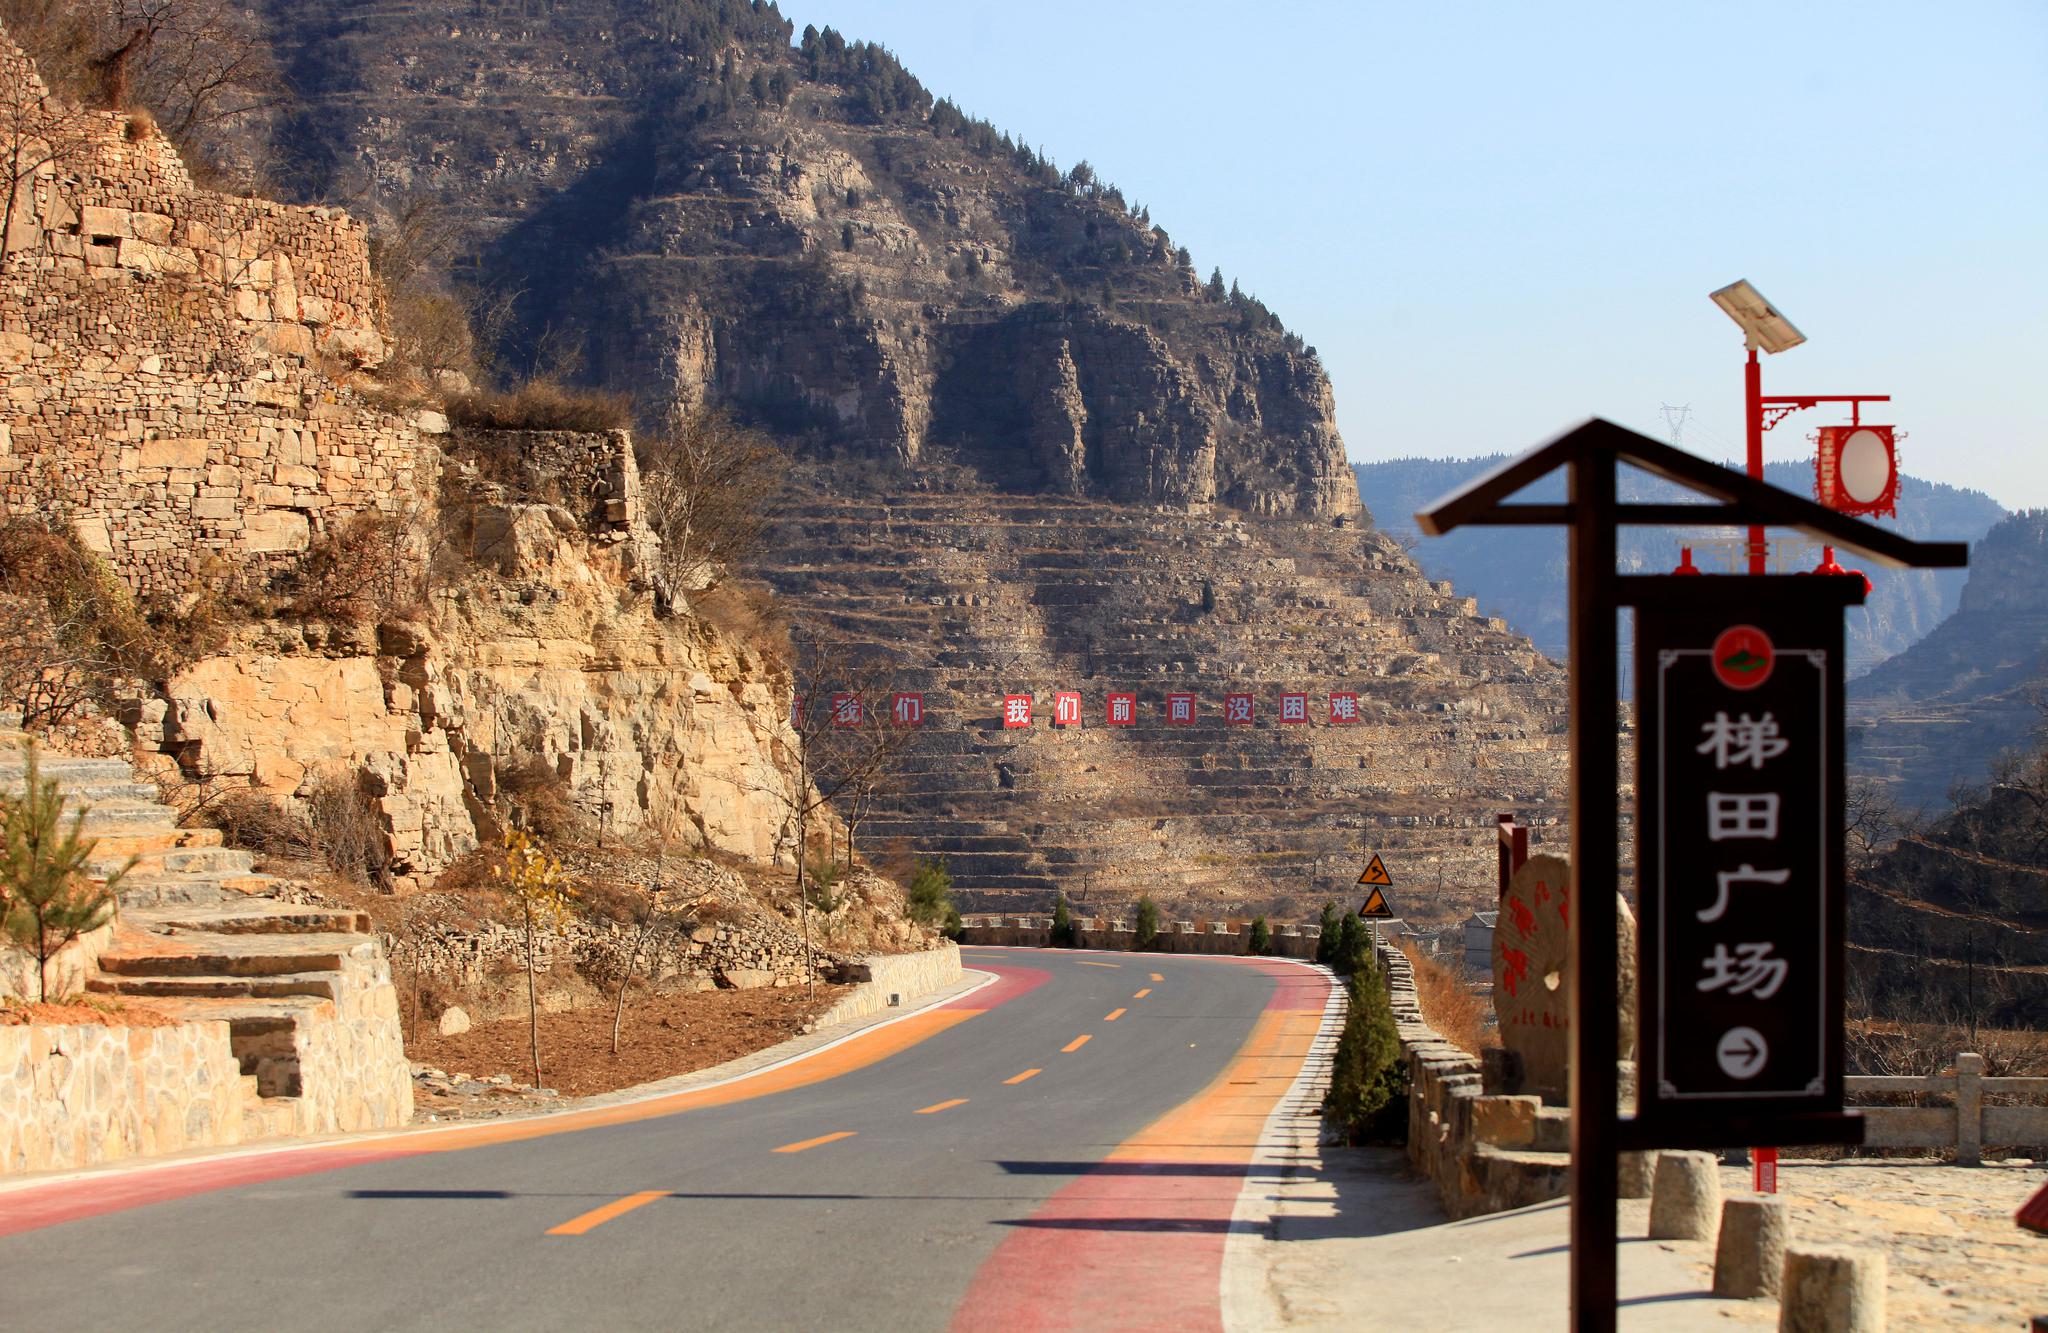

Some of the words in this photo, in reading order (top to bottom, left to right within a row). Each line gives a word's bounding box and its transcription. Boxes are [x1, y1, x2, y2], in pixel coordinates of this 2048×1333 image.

[1006, 696, 1356, 723] 我们前面没困难
[1696, 711, 1791, 999] 梯田广场
